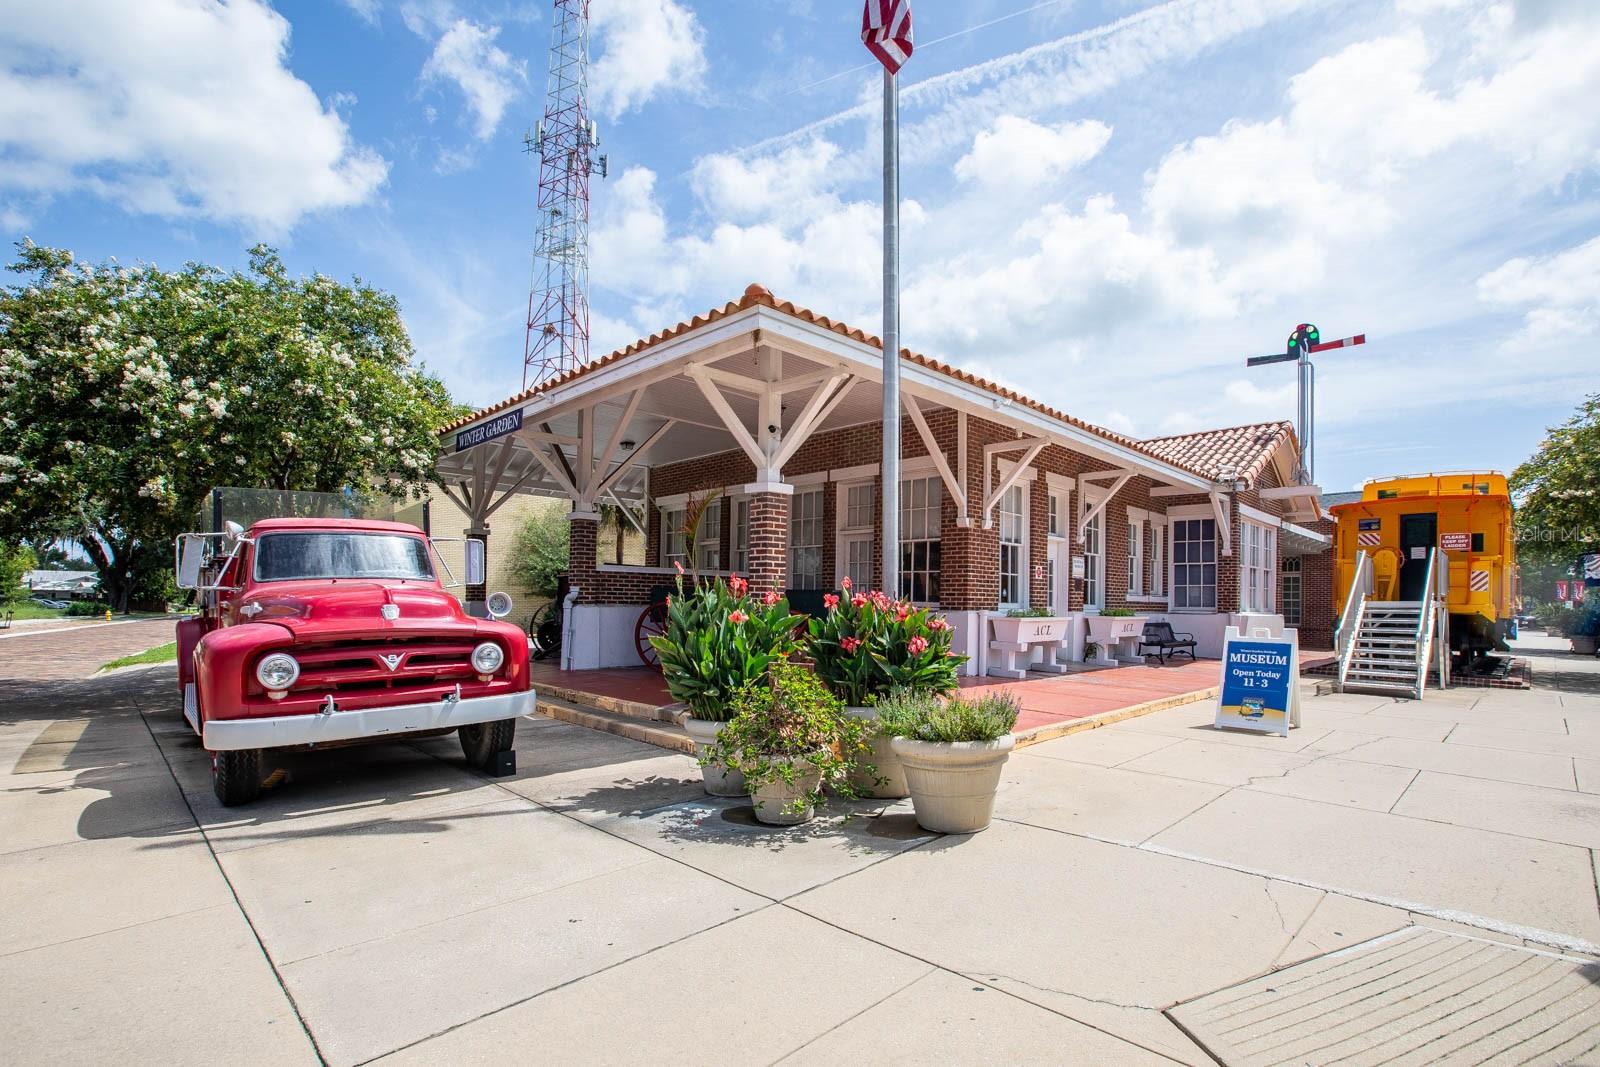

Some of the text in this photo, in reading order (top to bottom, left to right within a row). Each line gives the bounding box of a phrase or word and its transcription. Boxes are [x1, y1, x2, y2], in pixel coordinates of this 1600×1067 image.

[459, 413, 520, 448] WINTER GARDEN
[1230, 653, 1288, 666] MUSEUM
[1233, 669, 1281, 680] Open Today
[1243, 677, 1255, 687] 11
[1261, 679, 1269, 688] 3
